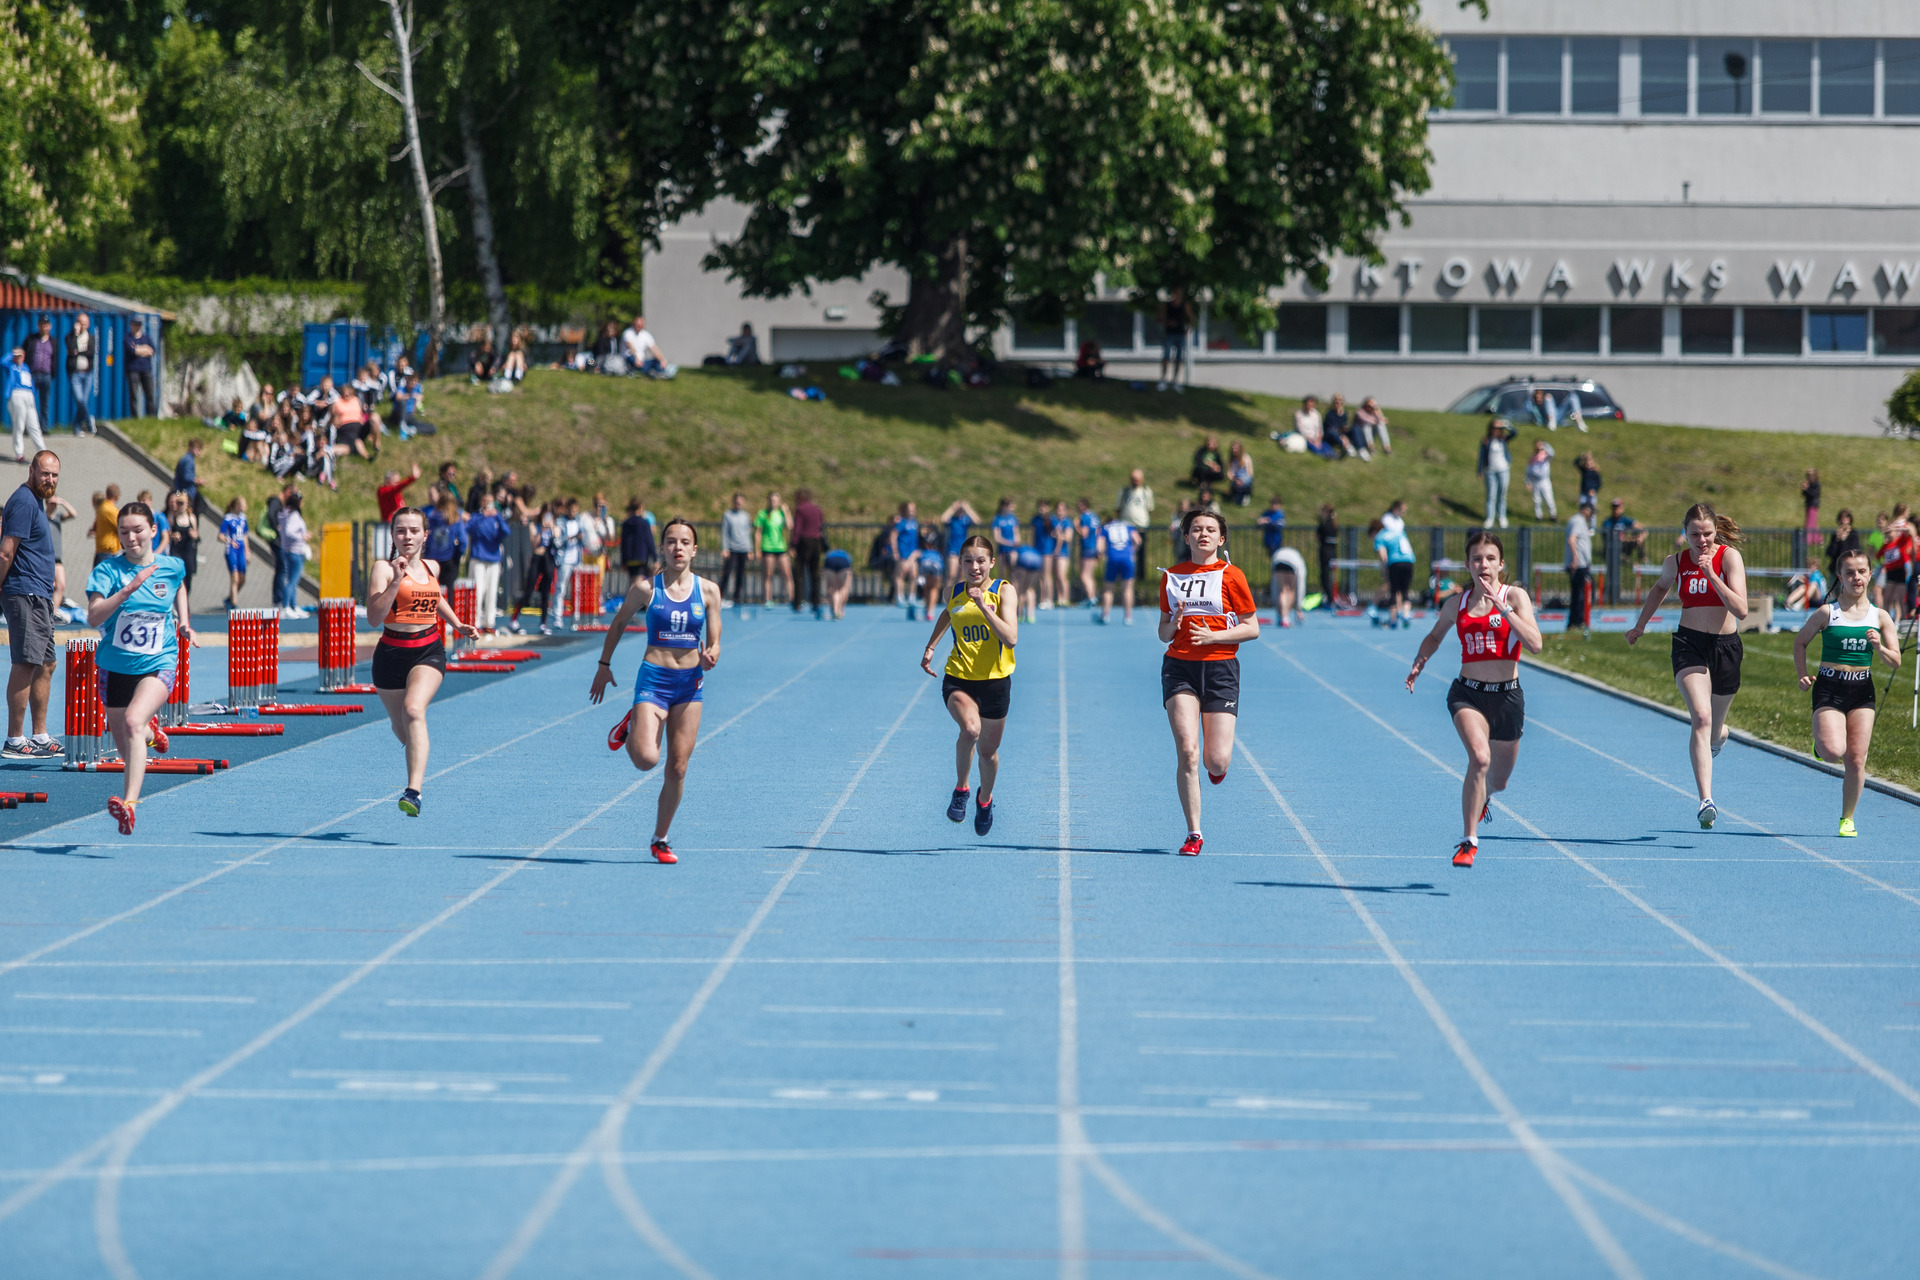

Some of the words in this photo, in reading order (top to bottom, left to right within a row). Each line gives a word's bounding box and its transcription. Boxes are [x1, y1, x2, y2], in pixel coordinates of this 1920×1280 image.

[1613, 257, 1728, 290] WKS
[1771, 257, 1920, 291] WAW
[1180, 579, 1206, 598] 47
[1689, 577, 1708, 594] 80
[410, 598, 437, 612] 293
[670, 610, 688, 632] 91
[120, 623, 157, 649] 631
[962, 624, 990, 643] 900
[1841, 637, 1868, 651] 133
[1838, 670, 1866, 681] NIKE
[1464, 679, 1480, 690] NIKE
[1483, 683, 1500, 693] NIKE
[1504, 679, 1518, 691] NIKE
